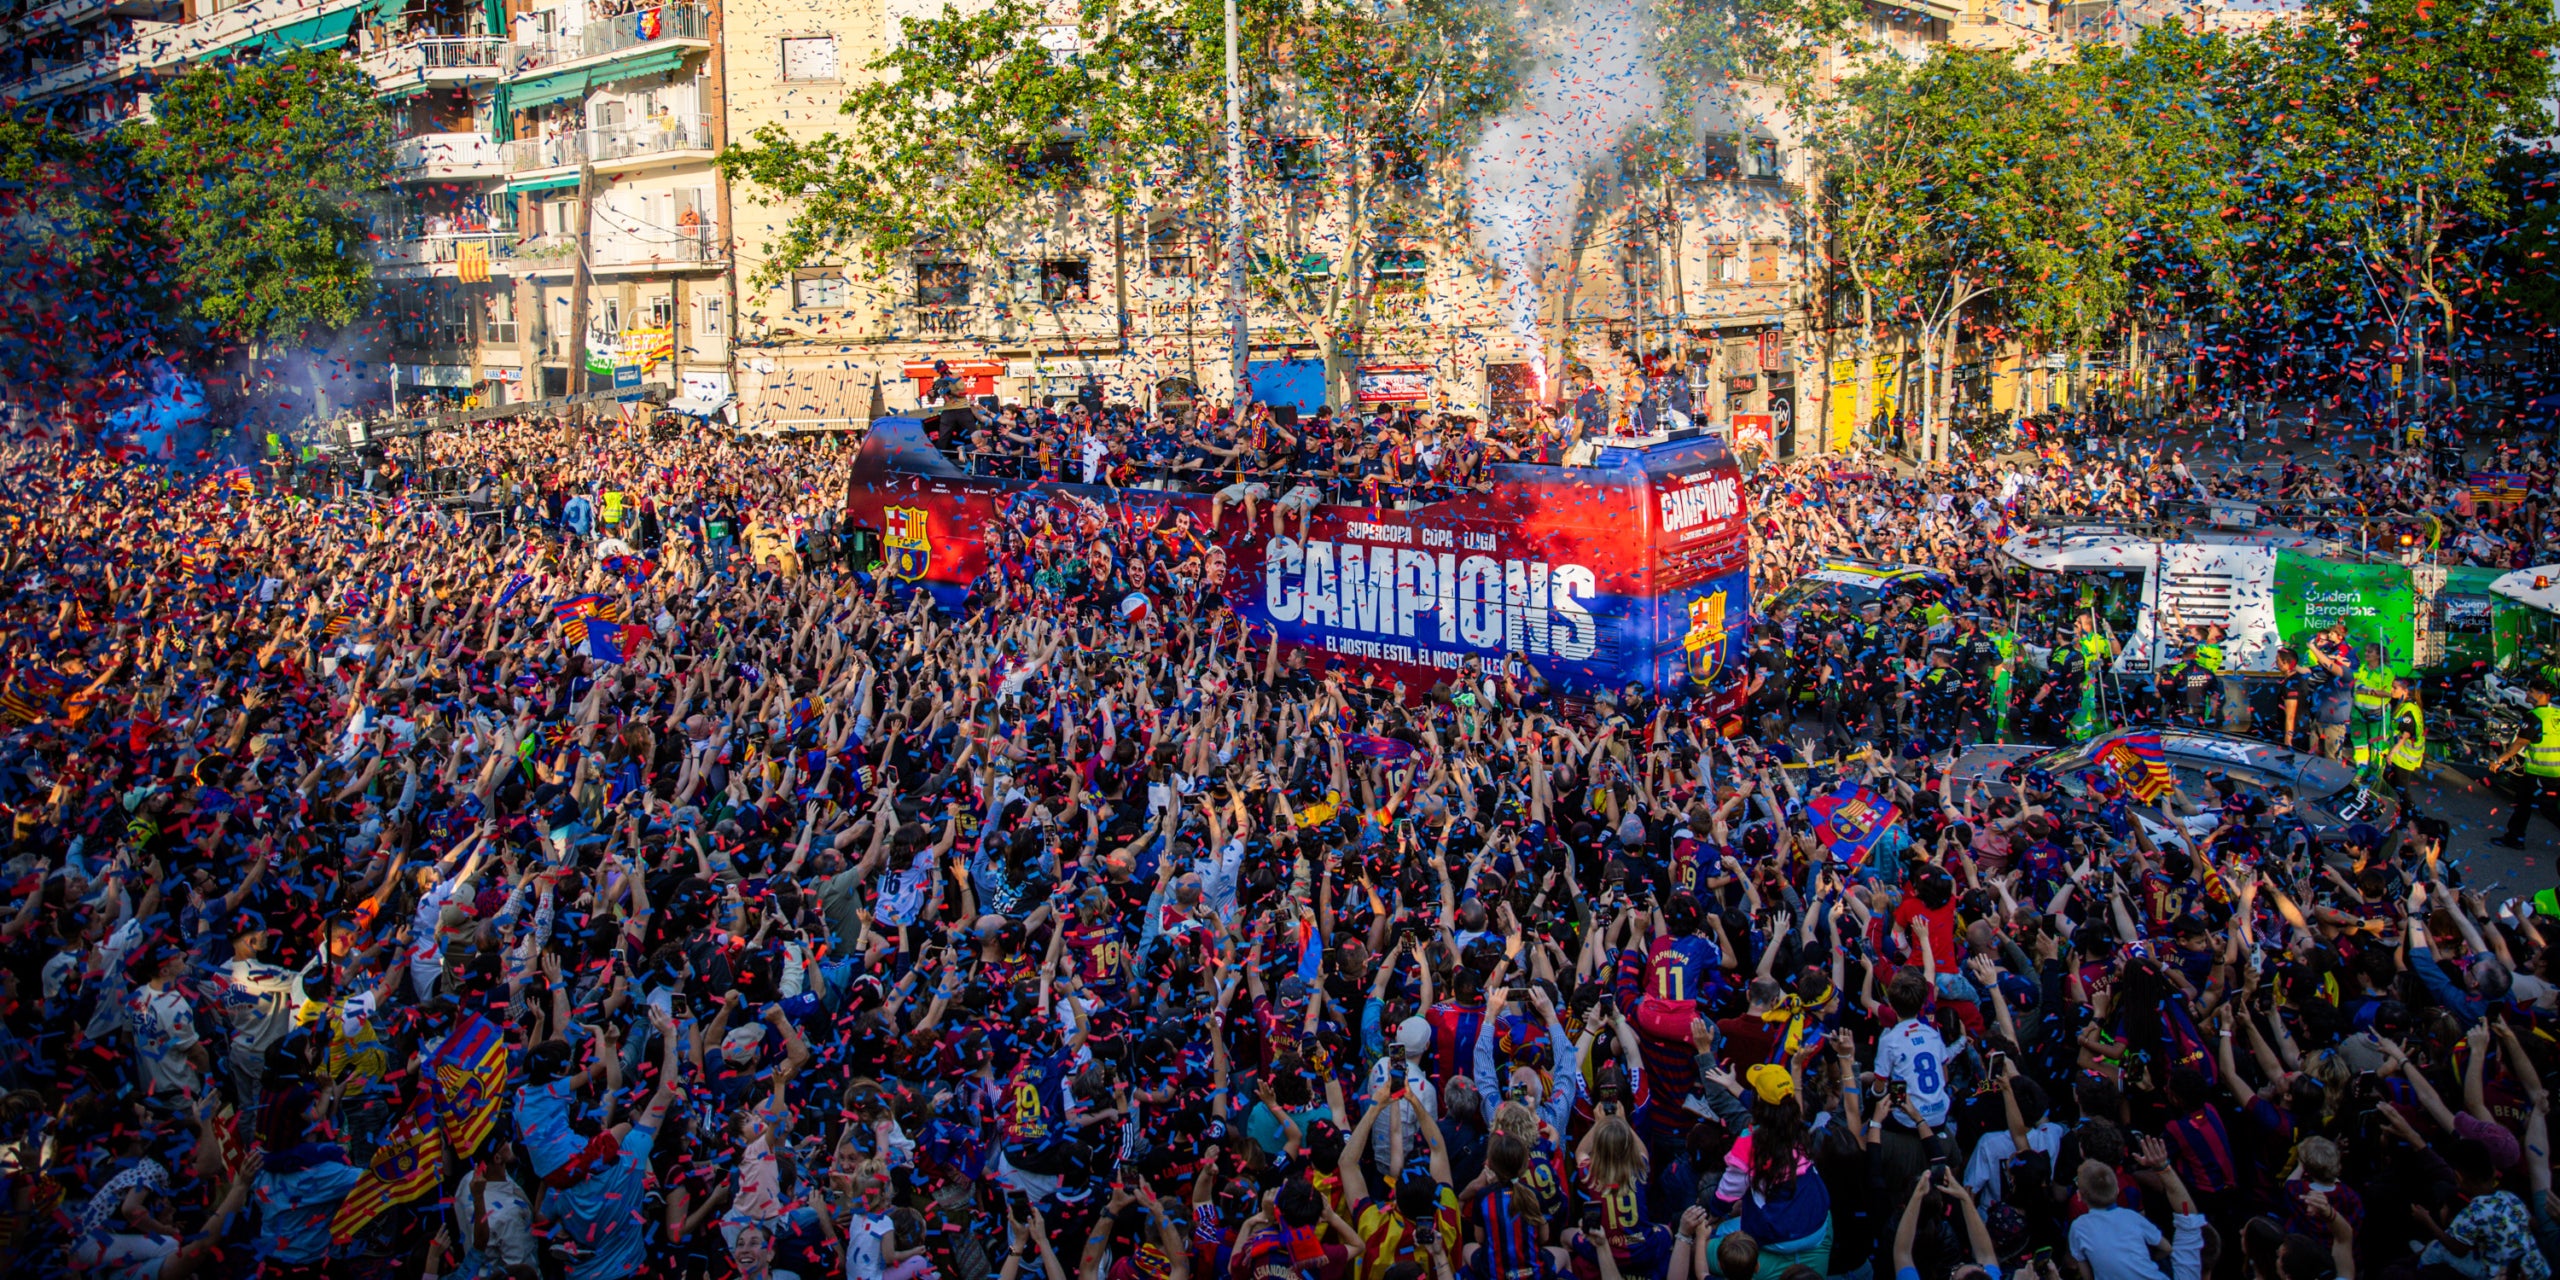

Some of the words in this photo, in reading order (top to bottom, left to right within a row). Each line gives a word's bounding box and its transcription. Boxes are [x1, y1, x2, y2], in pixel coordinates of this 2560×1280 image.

[1660, 477, 1739, 532] CAMPIONS
[1346, 521, 1412, 544] SUPERCOPA
[1422, 527, 1453, 548] COPA
[1463, 531, 1497, 552] LLIGA
[1265, 536, 1596, 661] CAMPIONS
[2304, 603, 2376, 617] Barcelona
[2305, 590, 2361, 603] Cuidem
[1326, 636, 1339, 652] EL
[1339, 637, 1381, 659] NOSTRE
[1383, 644, 1417, 667] ESTIL,
[1418, 649, 1432, 666] EL
[1433, 650, 1466, 670] NOST
[883, 870, 901, 896] 16
[1681, 863, 1697, 891] 19
[2153, 890, 2182, 923] 19
[1091, 940, 1120, 978] 19
[1655, 966, 1684, 1001] 11
[1913, 1052, 1940, 1094] 8
[1012, 1083, 1041, 1124] 19
[1521, 1163, 1557, 1200] 19
[1601, 1189, 1639, 1230] 19
